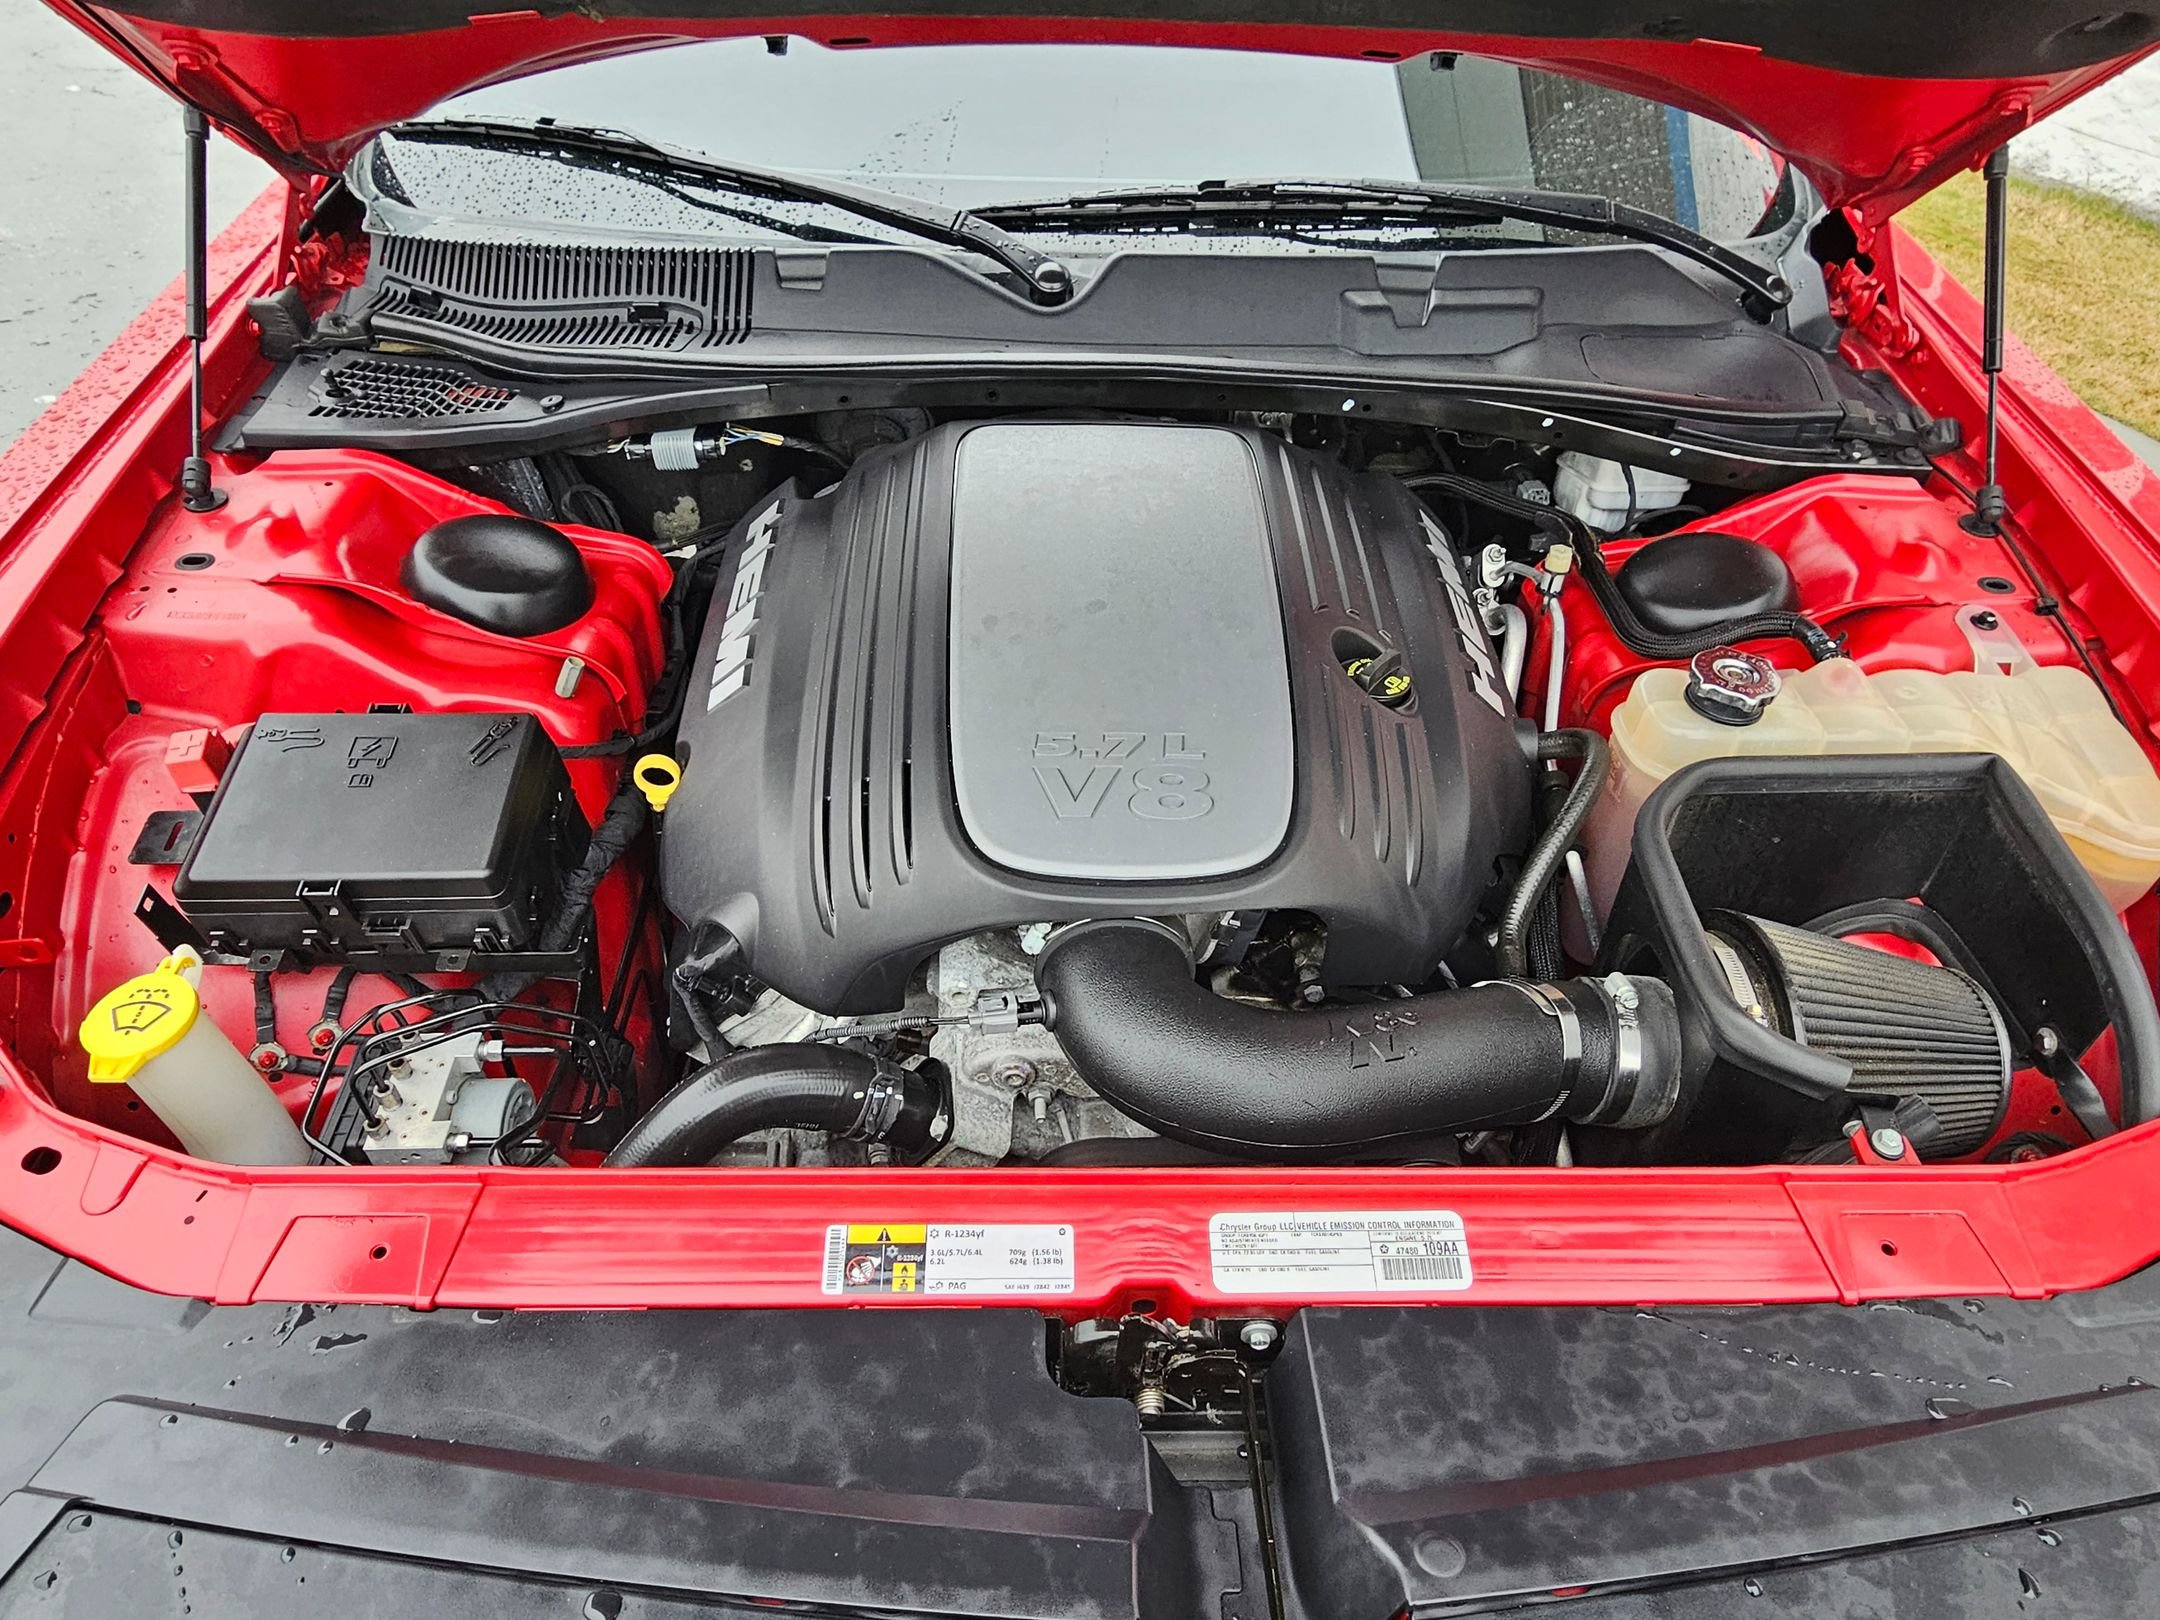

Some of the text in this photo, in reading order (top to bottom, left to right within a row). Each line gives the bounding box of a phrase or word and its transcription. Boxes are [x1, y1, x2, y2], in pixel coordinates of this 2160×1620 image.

[707, 499, 783, 713] HEMI
[1418, 508, 1506, 718] HEMI
[1032, 731, 1207, 760] 5.7L
[1032, 763, 1215, 820] V8
[1219, 1222, 1294, 1232] Chrysler Group LLC
[1296, 1220, 1455, 1230] VEHICLE EMISSION CONTROL INFORMATION
[944, 1229, 985, 1240] R-1234yf
[930, 1248, 1062, 1257] 3.6L/5.7L/6.4L 709g (1.56 lb)
[1423, 1241, 1460, 1256] 109AA
[1009, 1258, 1028, 1266] 624g
[1032, 1257, 1052, 1266] (1.38
[1053, 1257, 1063, 1266] lb)
[948, 1282, 967, 1290] PAG
